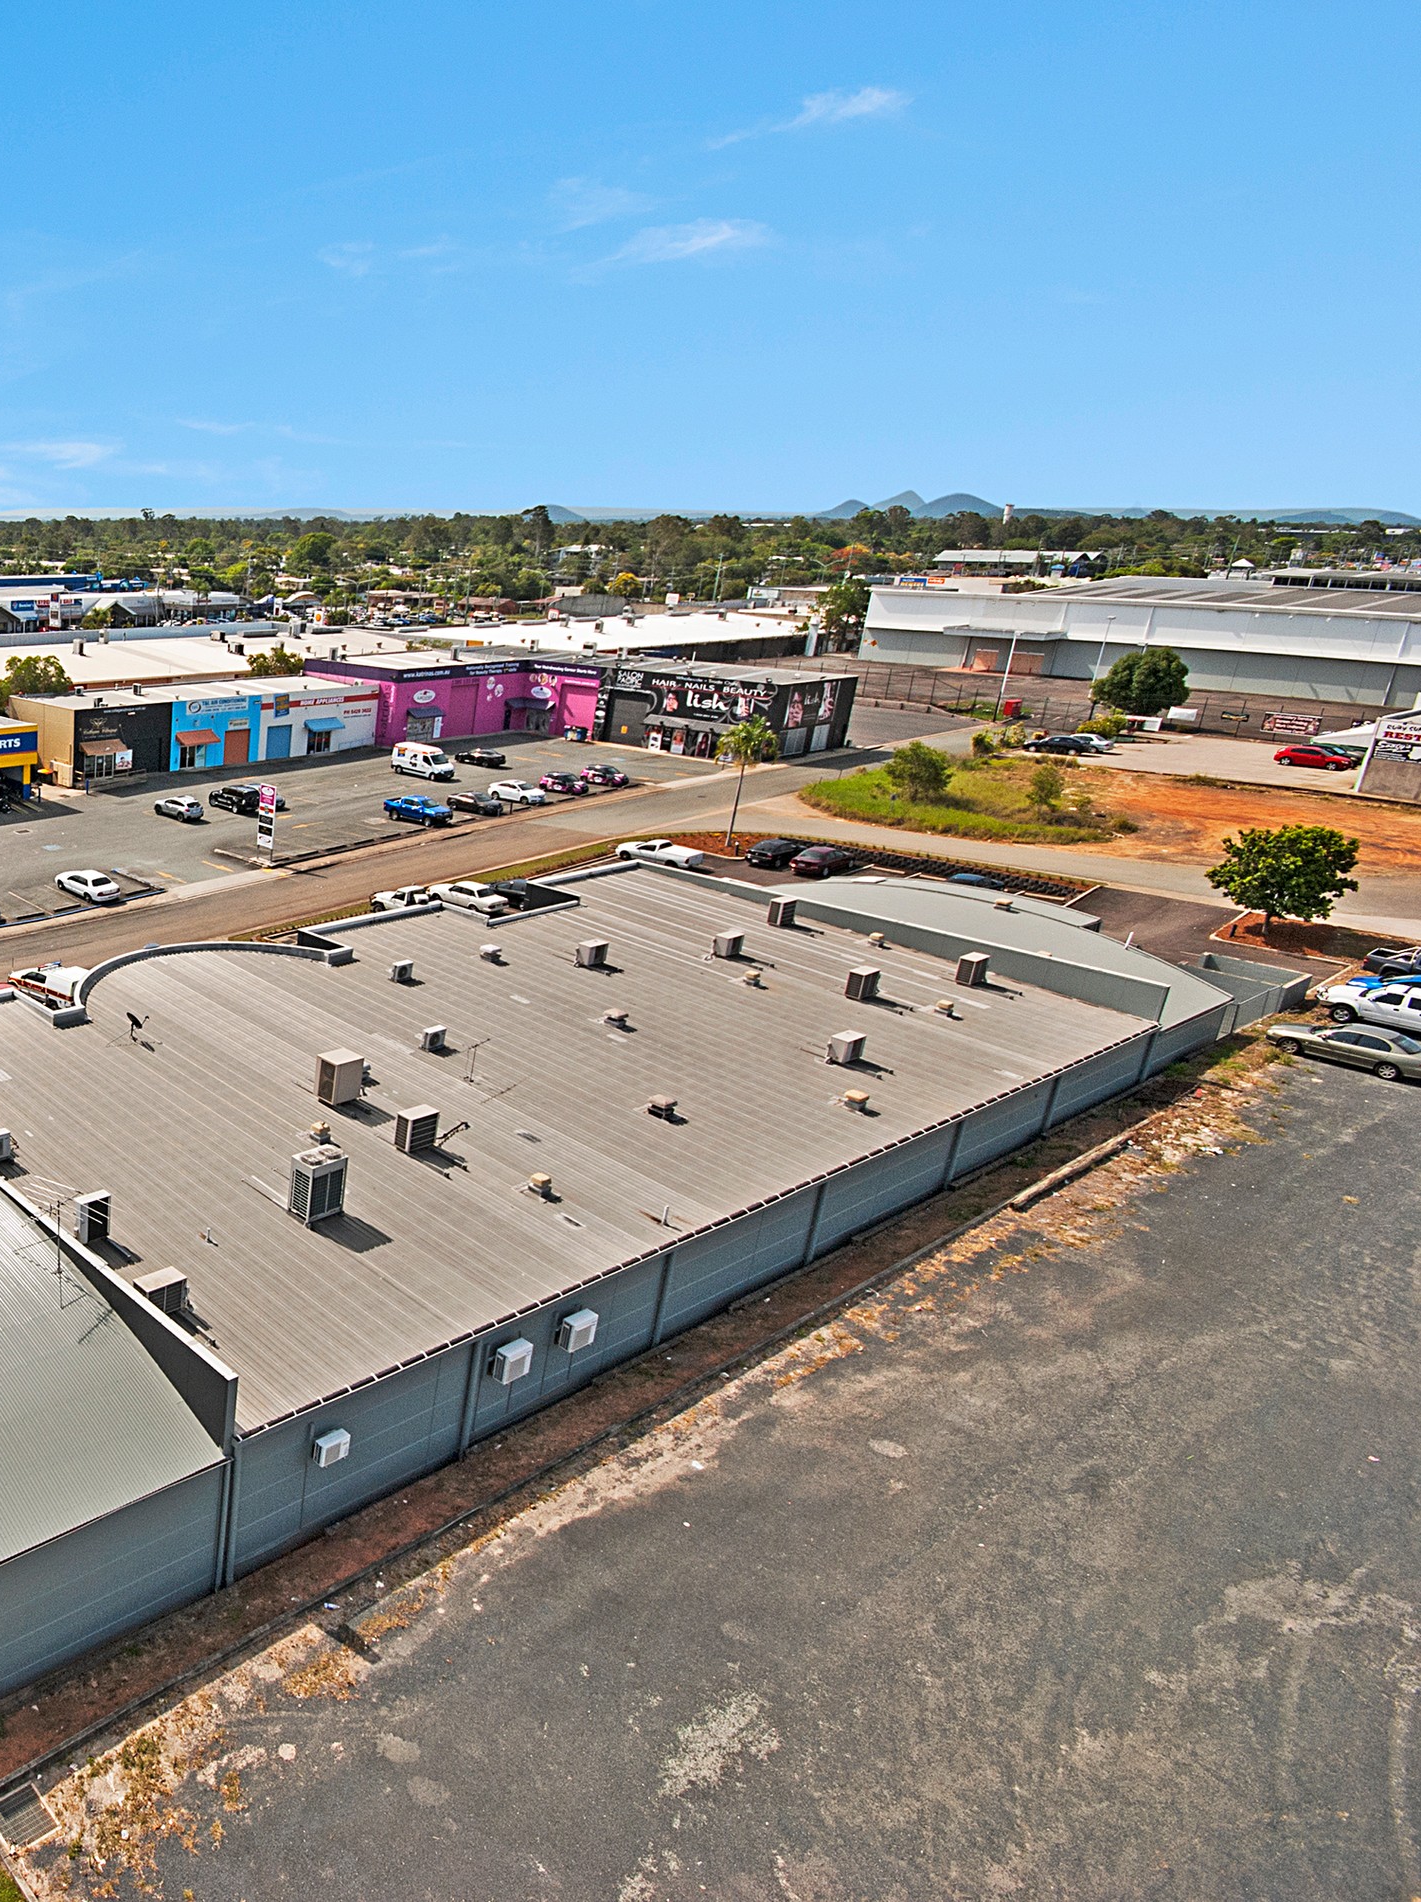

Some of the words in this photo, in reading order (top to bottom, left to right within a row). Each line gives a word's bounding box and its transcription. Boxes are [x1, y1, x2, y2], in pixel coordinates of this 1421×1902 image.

[618, 670, 644, 680] SALON
[652, 678, 677, 688] HAIR
[685, 682, 715, 692] NAILS
[723, 687, 767, 697] BEAUTY
[315, 697, 345, 705] APPLIANCES
[686, 690, 730, 711] lish
